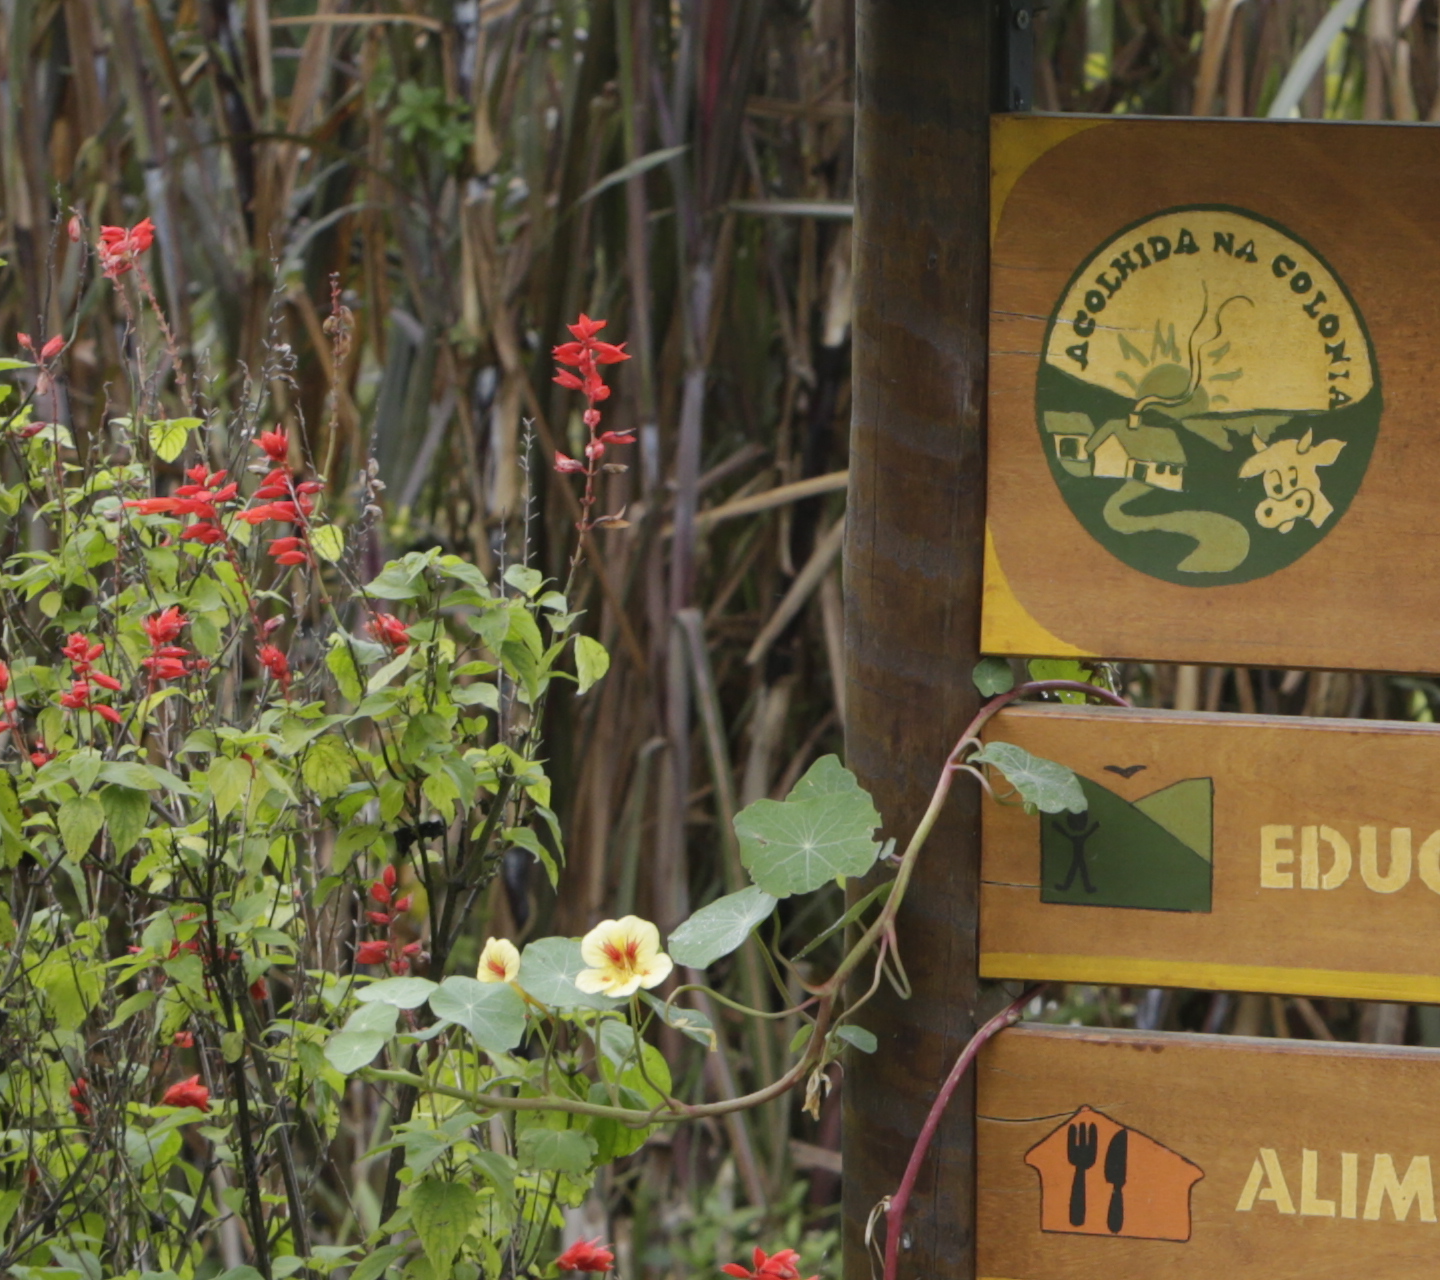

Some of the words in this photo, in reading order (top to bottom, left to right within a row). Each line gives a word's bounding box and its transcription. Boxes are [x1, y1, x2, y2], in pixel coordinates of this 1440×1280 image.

[1066, 228, 1199, 371] ACOLHIDA
[1213, 231, 1258, 263] NA
[1271, 254, 1352, 410] COLONIA
